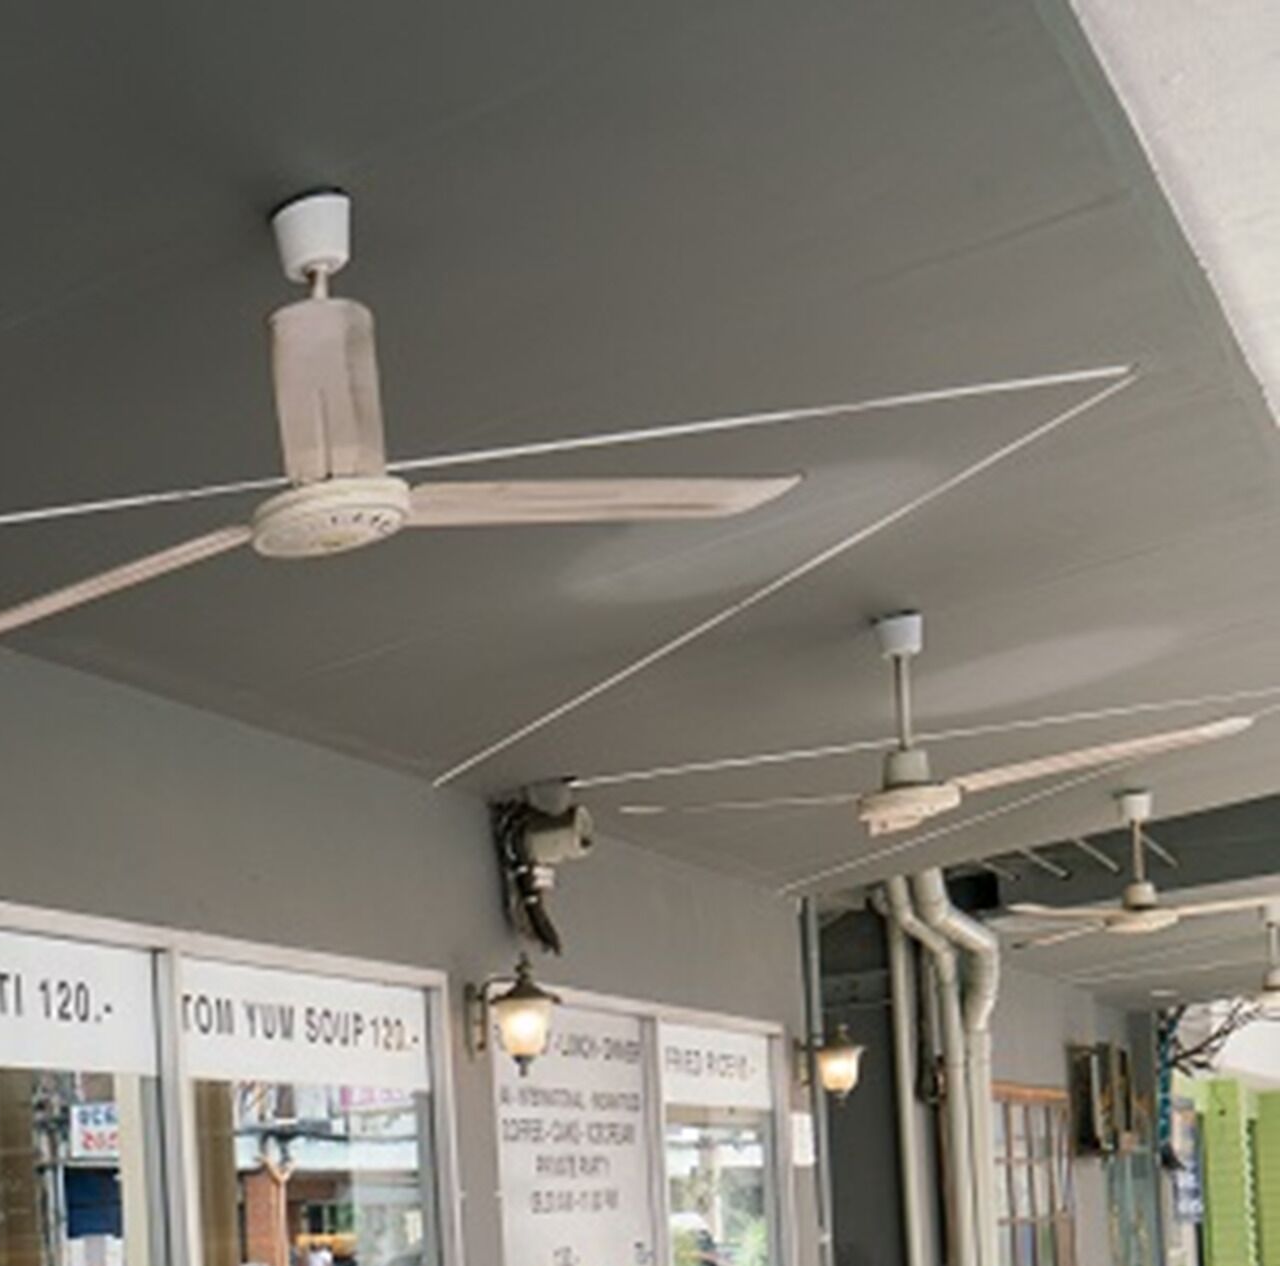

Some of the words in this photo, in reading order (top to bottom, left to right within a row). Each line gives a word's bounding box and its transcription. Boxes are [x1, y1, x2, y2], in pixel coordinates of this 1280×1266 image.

[39, 979, 113, 1024] 120.-
[181, 994, 236, 1036] TOM
[242, 1000, 296, 1040] YUM
[305, 1006, 365, 1047] SOUP
